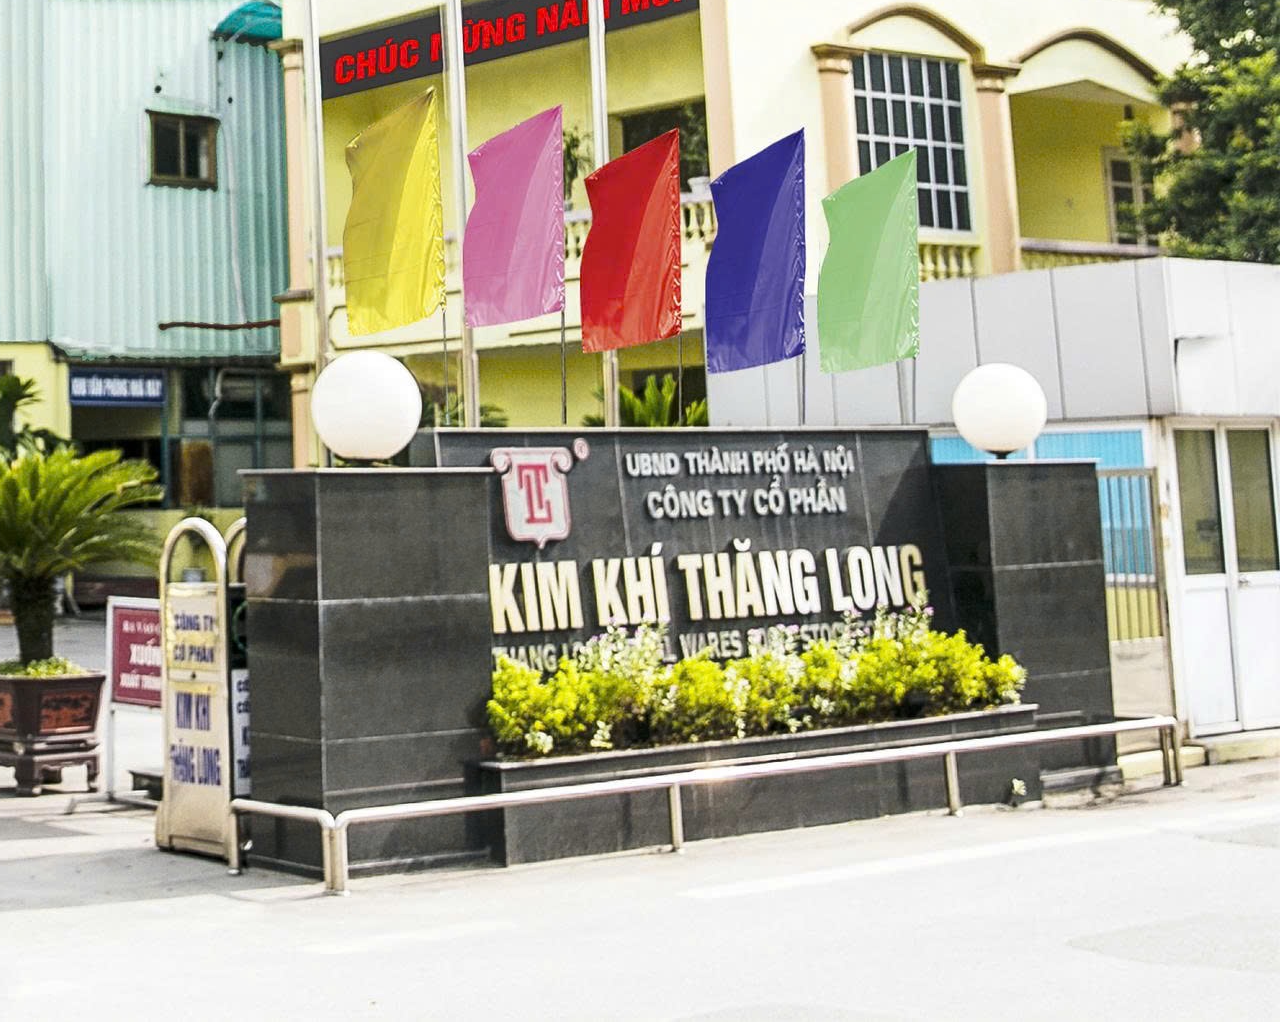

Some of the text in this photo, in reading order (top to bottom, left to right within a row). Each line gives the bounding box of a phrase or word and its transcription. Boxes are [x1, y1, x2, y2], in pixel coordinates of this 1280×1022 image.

[334, 35, 419, 84] CHÚC
[625, 442, 855, 478] UBND THÀNH PHỐ HÀ NỘI
[647, 474, 848, 519] CÔNG TY CỔ PHẦN
[489, 538, 928, 634] KIM KHÍ THĂNG LONG
